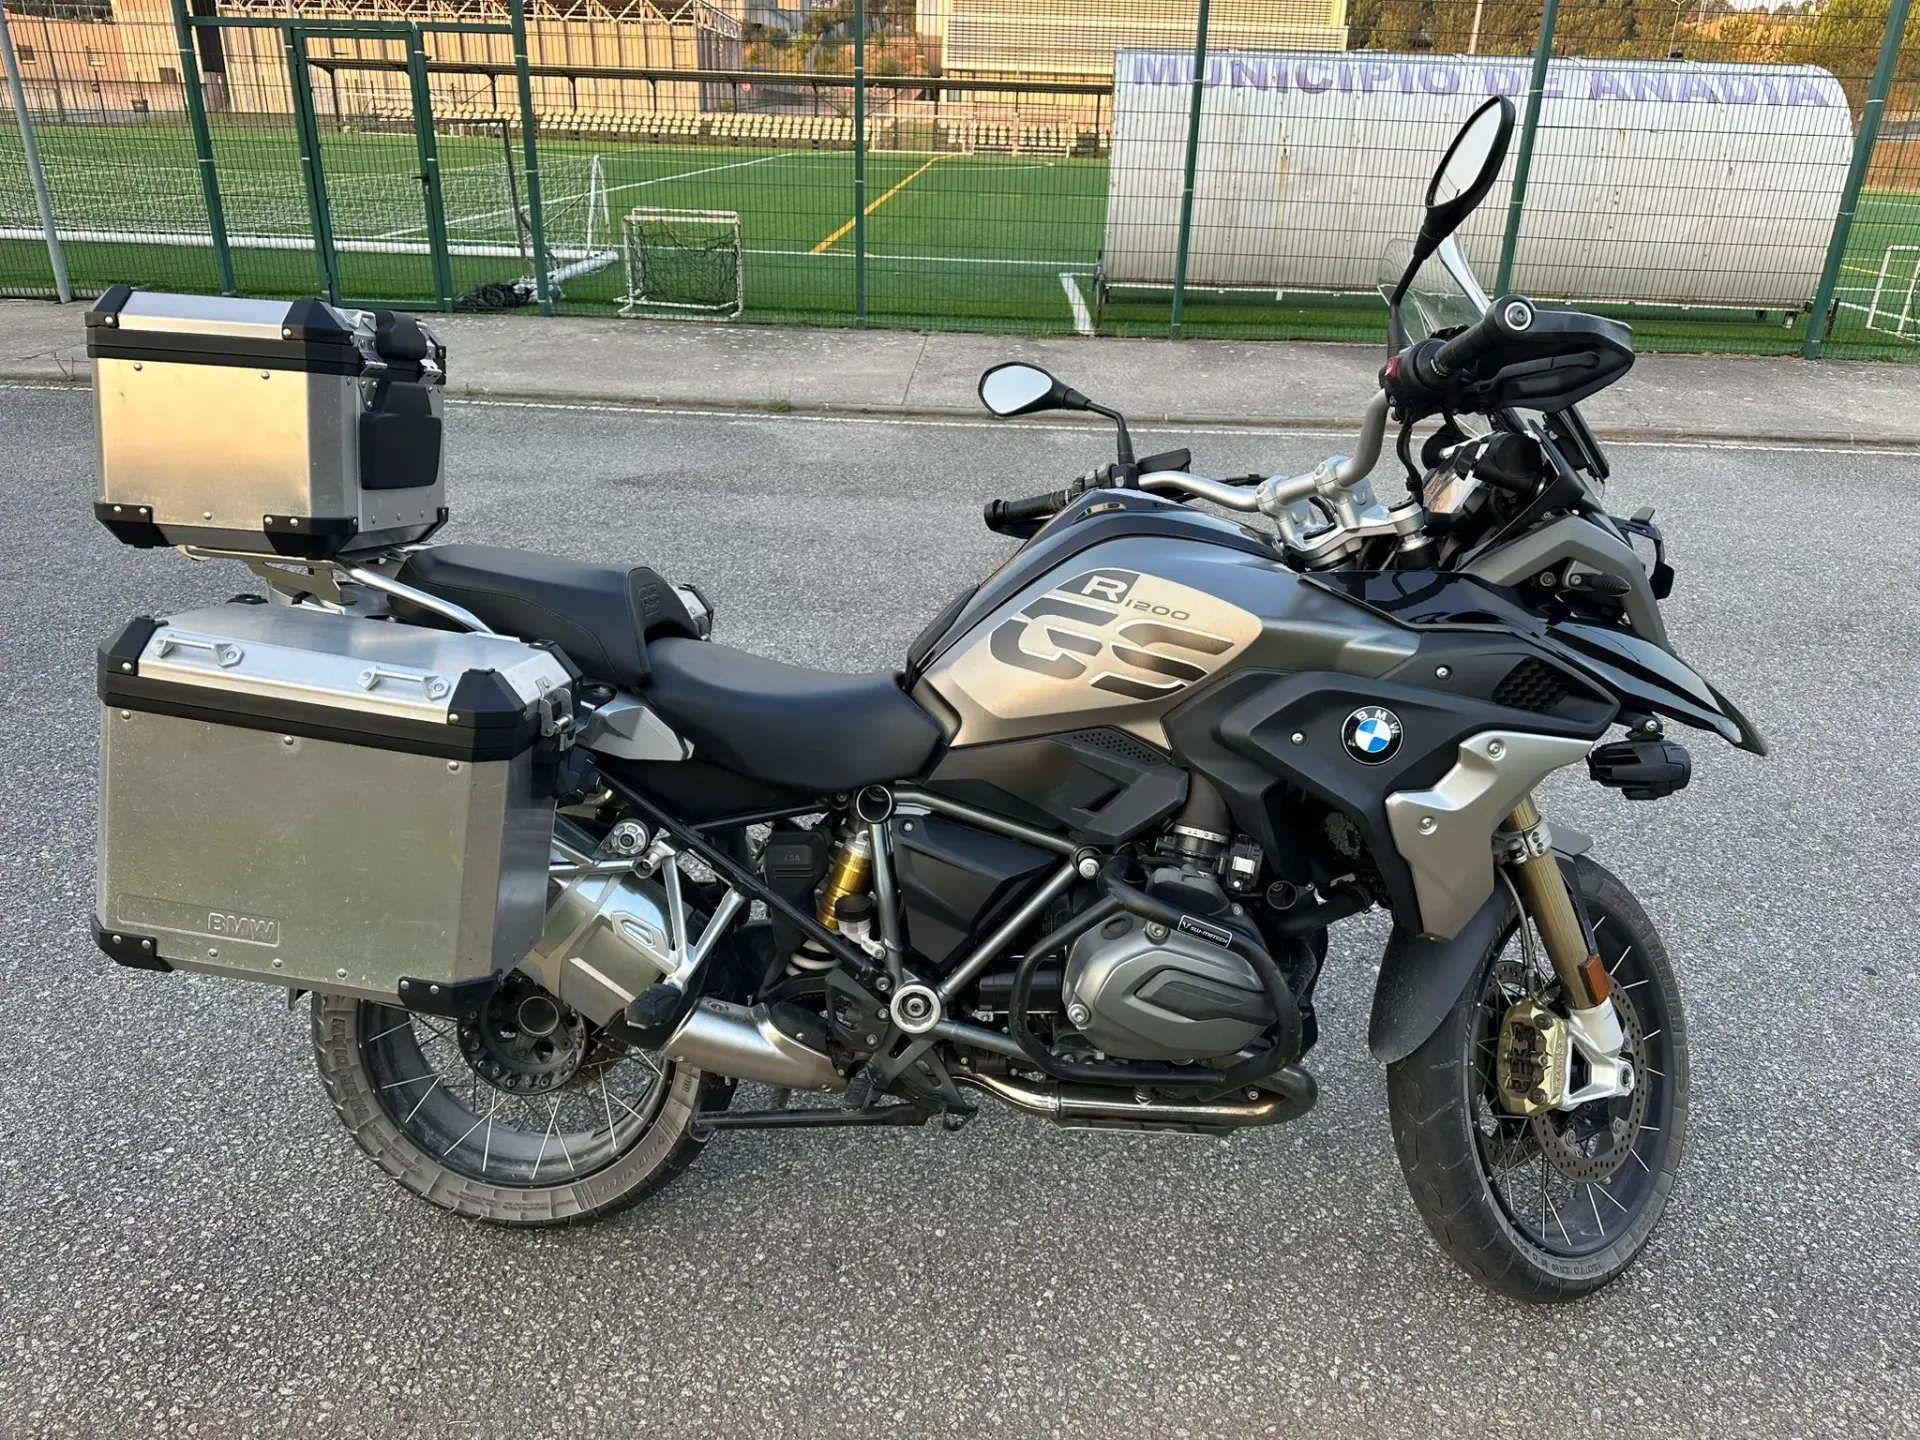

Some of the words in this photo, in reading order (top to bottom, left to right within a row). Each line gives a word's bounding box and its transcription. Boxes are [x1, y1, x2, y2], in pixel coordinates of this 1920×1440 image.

[1481, 66, 1564, 98] DE
[1590, 71, 1832, 107] ANADIA
[1081, 575, 1128, 602] R
[1125, 600, 1191, 622] 1200
[988, 595, 1237, 701] GS
[1354, 708, 1401, 734] BMW
[207, 912, 276, 942] BMW
